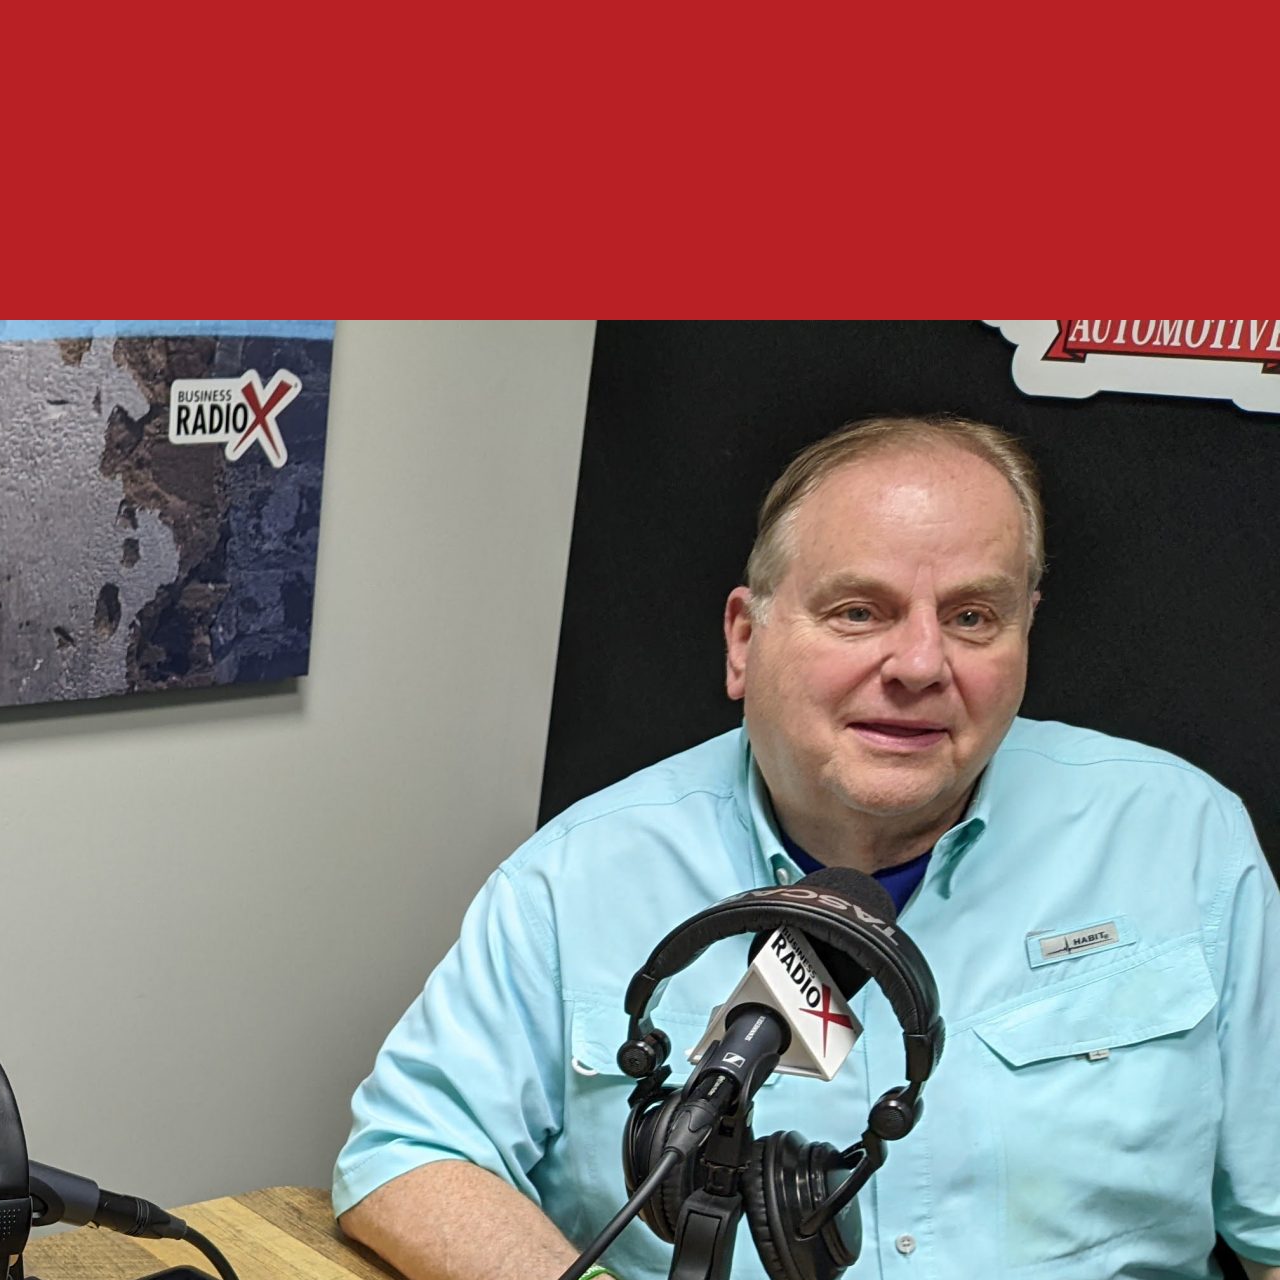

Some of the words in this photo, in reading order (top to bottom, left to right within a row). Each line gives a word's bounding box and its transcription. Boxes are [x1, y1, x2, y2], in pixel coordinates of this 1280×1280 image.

[178, 389, 232, 403] BUSINESS
[1073, 931, 1106, 946] HABIT
[781, 927, 817, 979] BUSINESS
